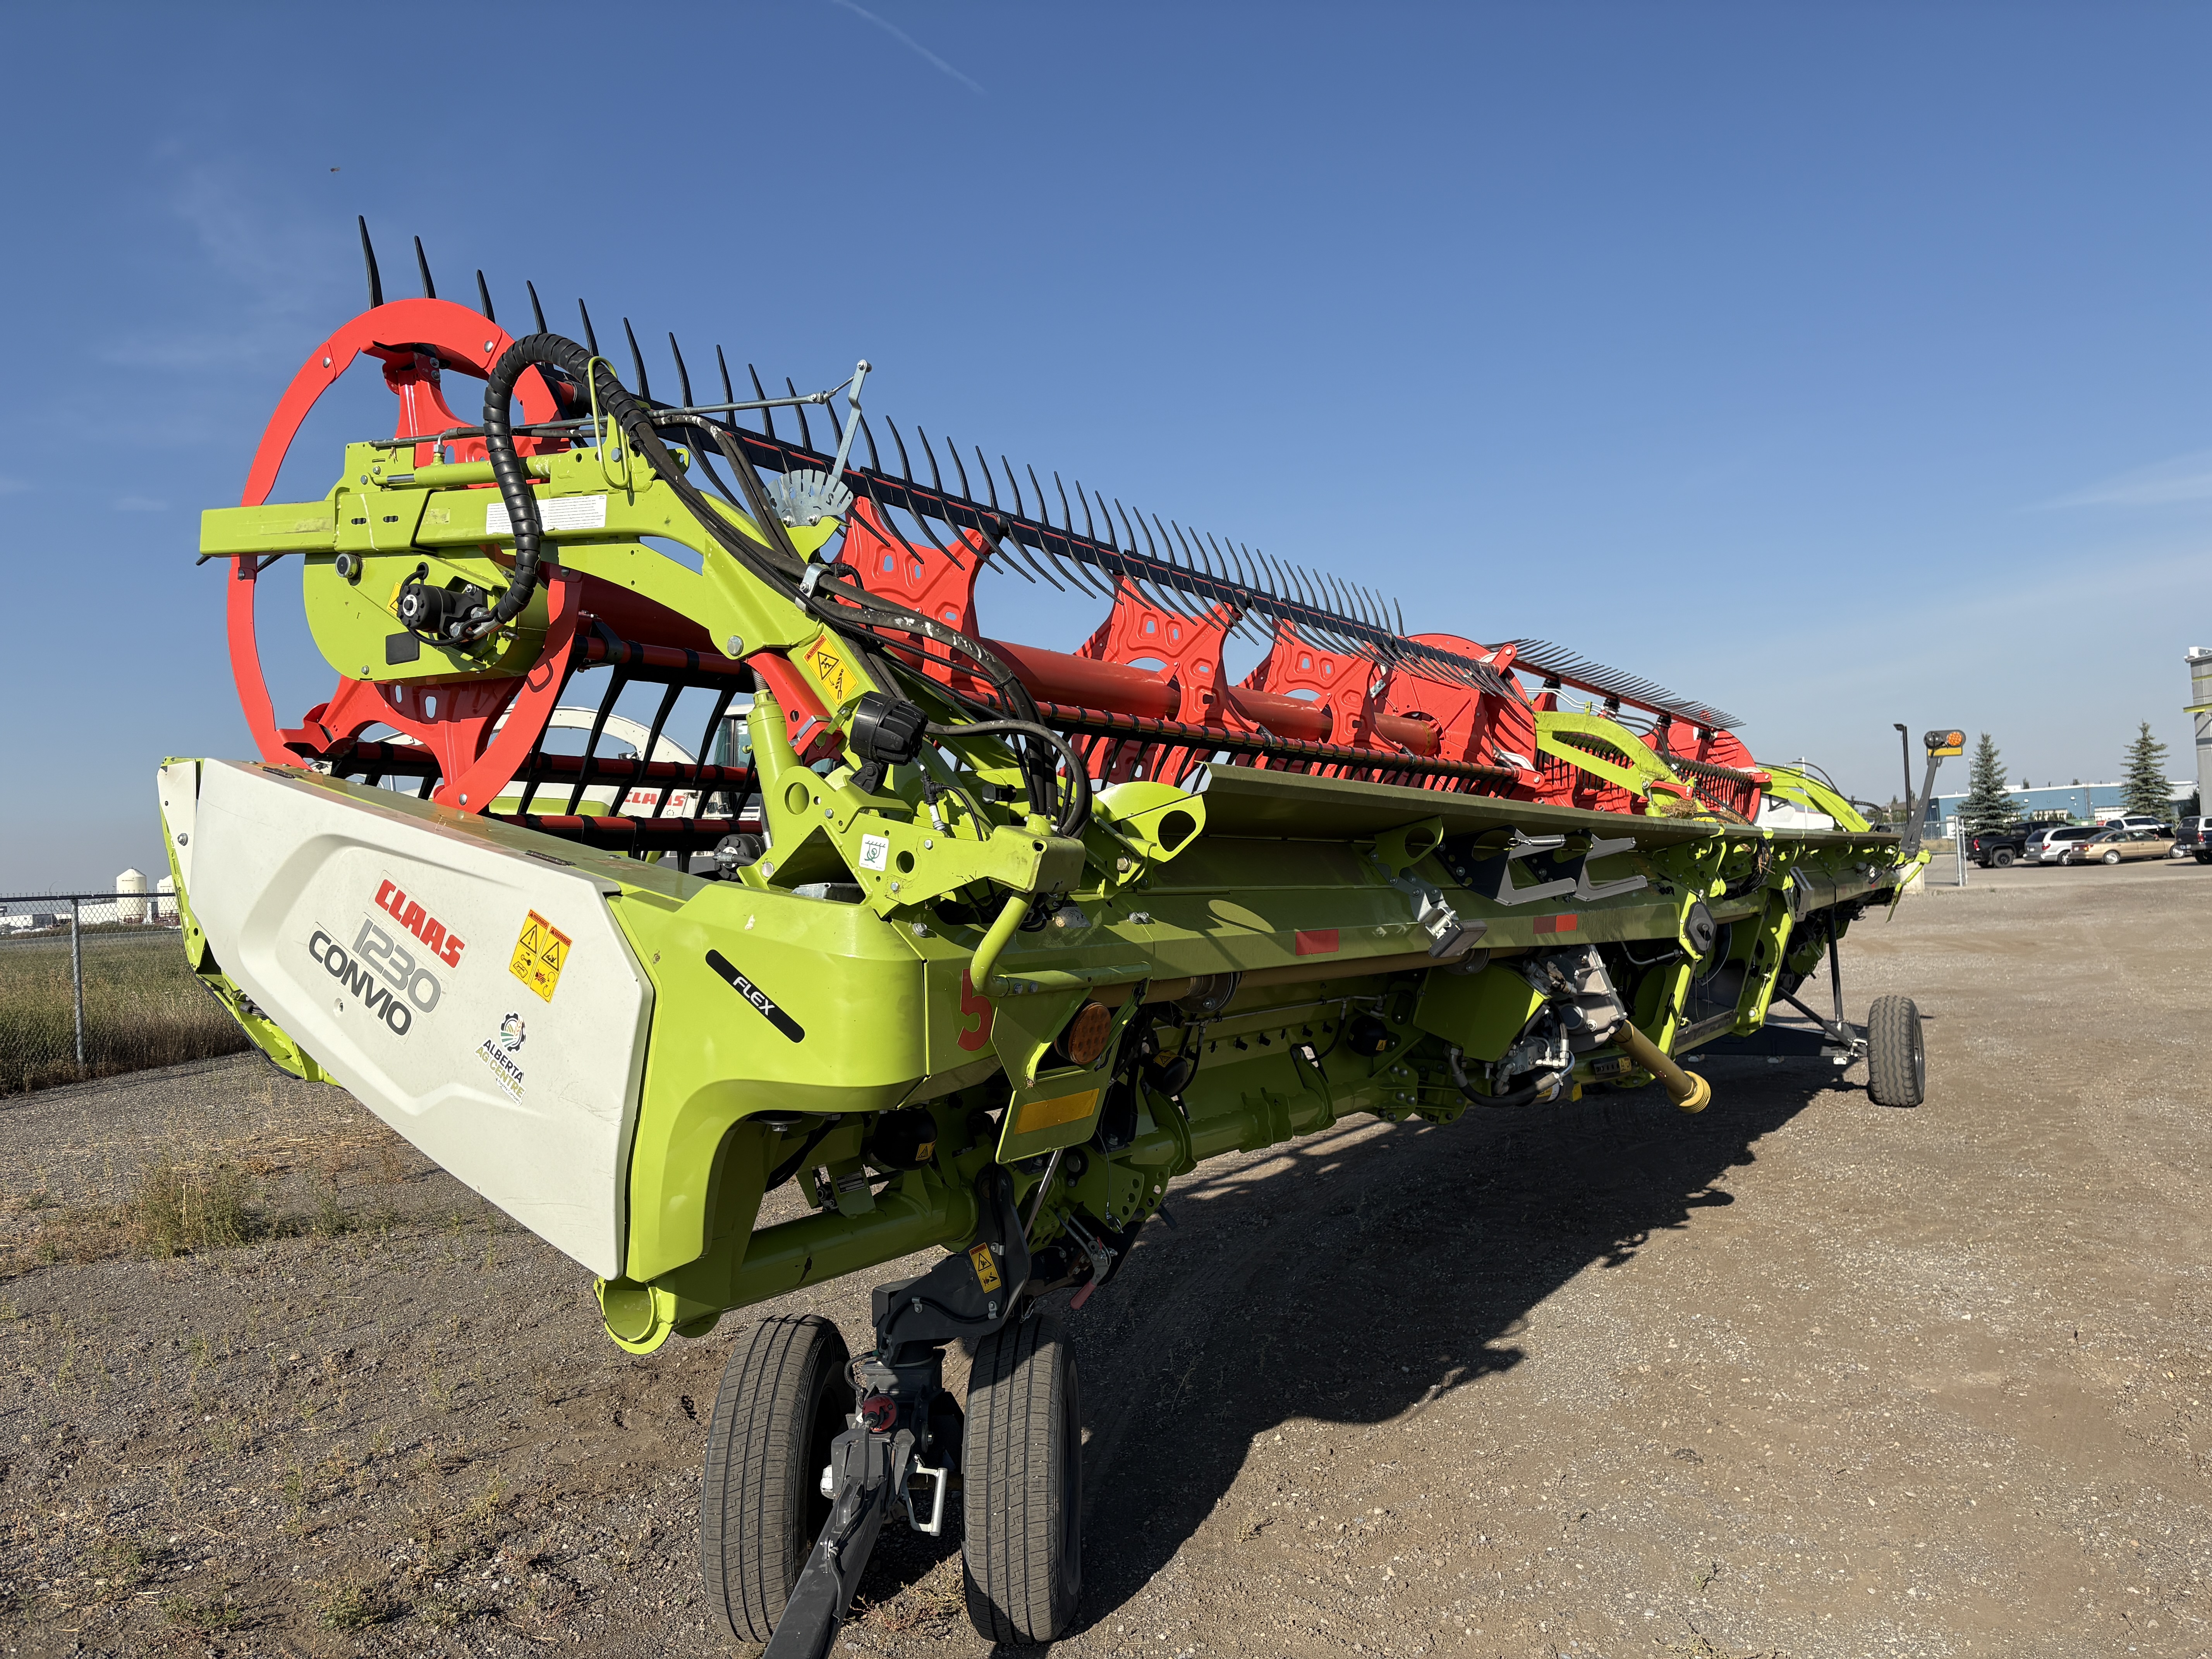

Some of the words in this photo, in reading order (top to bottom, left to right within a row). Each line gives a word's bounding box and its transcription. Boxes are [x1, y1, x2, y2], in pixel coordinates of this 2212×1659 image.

[809, 637, 825, 655] WARNING
[375, 879, 465, 968] CLAAS
[532, 913, 548, 928] WARNING
[555, 931, 570, 946] WARNING
[309, 931, 411, 1036] CONVIO
[352, 919, 441, 1013] 1230
[733, 976, 775, 1016] FLEX
[957, 968, 993, 1051] 5
[475, 1046, 489, 1063] AG
[489, 1059, 525, 1098] CENTRE
[483, 1039, 523, 1084] ALBERTA
